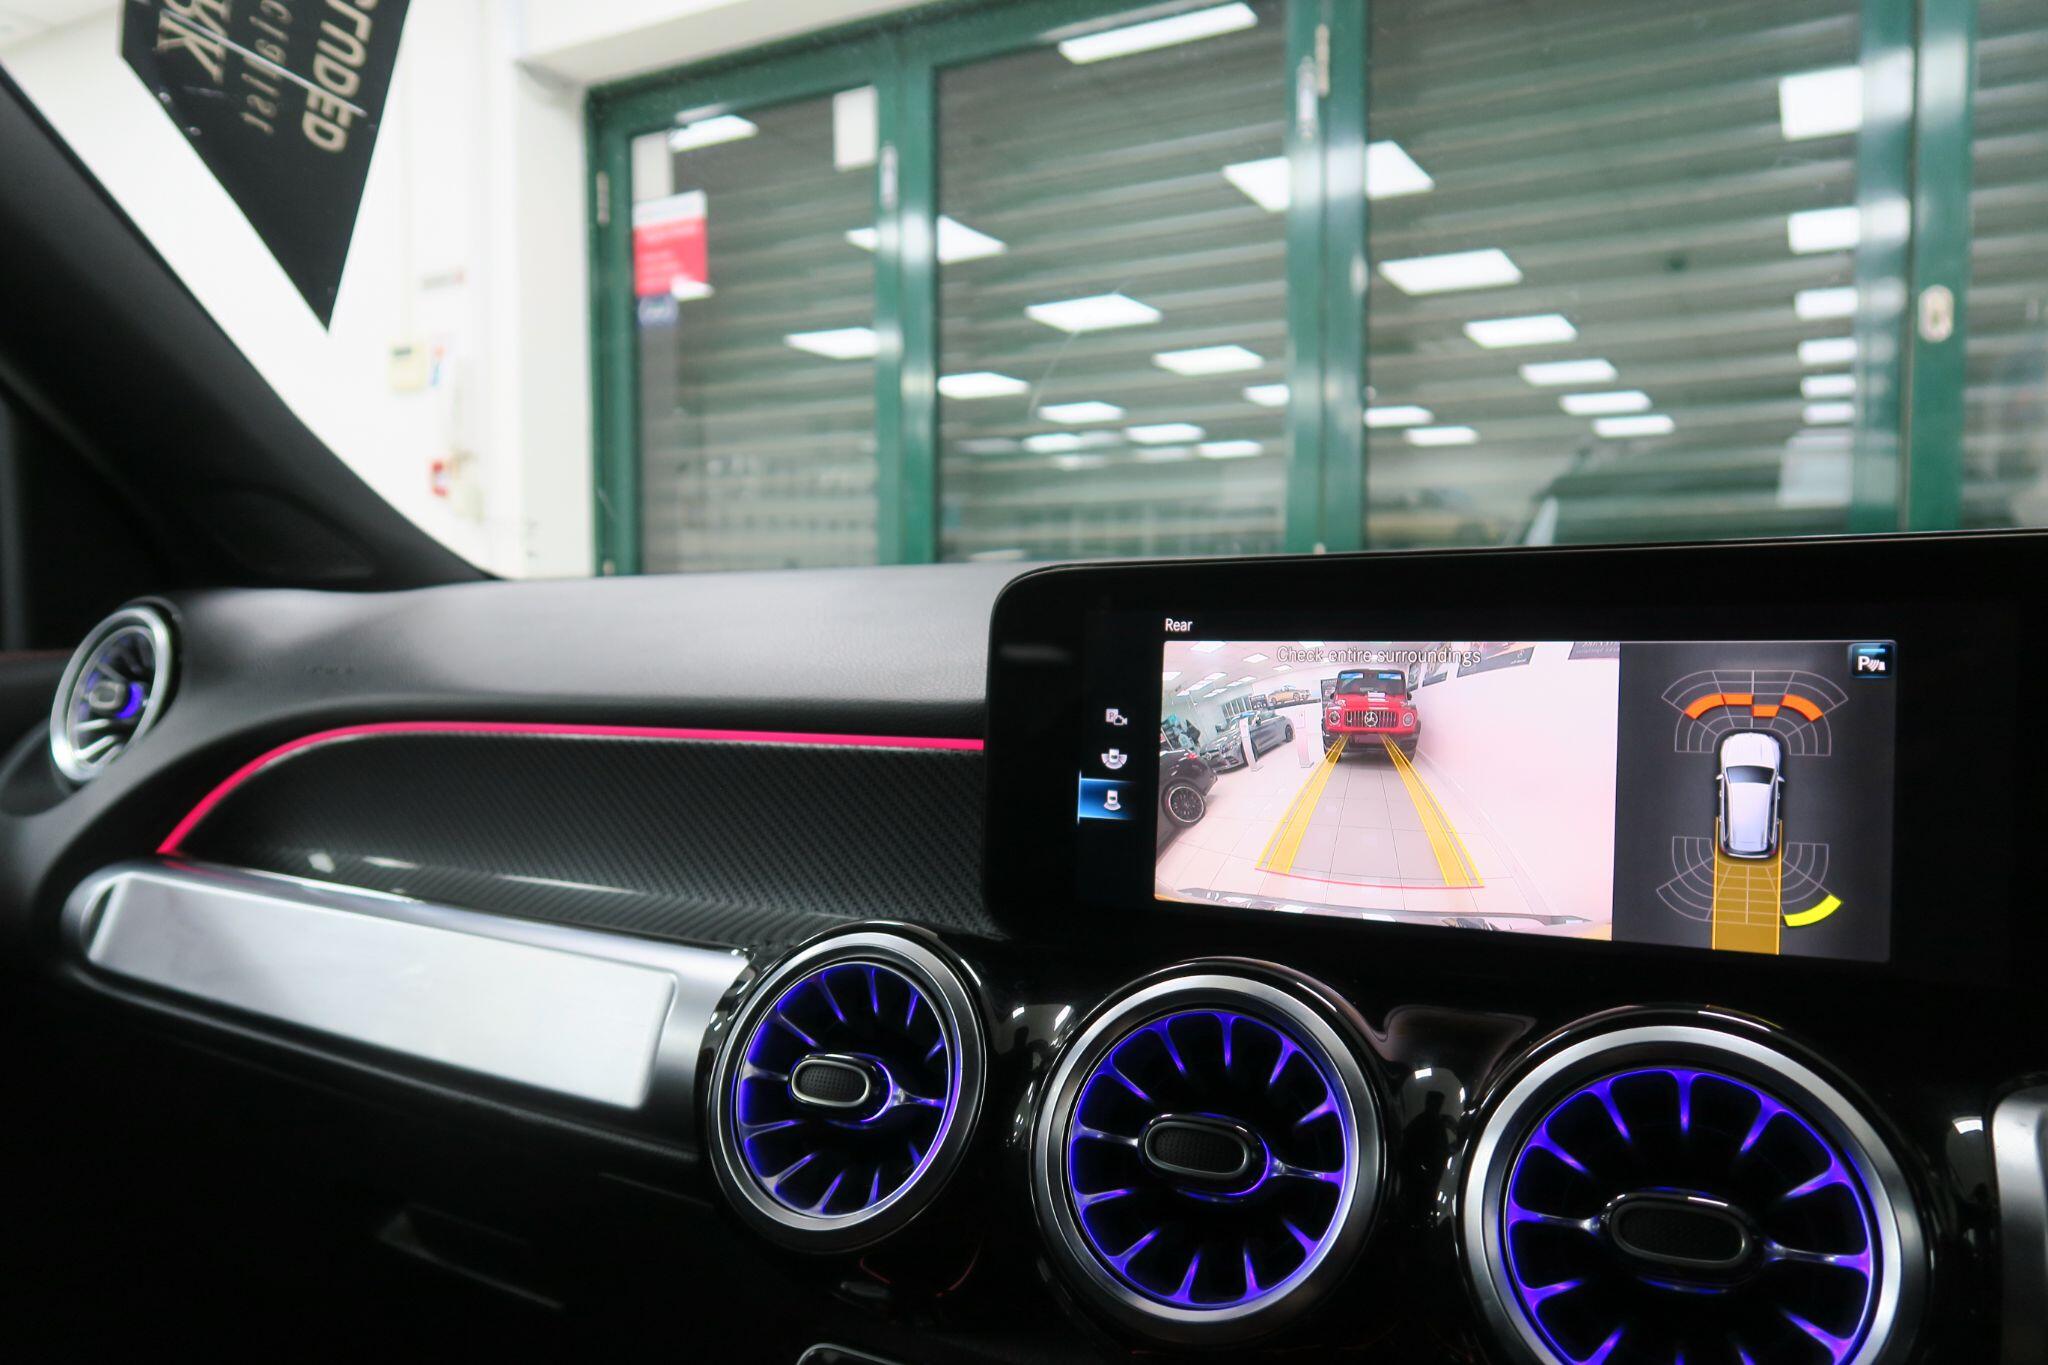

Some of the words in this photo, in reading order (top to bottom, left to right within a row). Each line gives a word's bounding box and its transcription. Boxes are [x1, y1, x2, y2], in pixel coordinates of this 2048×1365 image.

[1164, 617, 1194, 632] Rear
[1276, 645, 1324, 664] Check
[1328, 646, 1373, 664] entire
[1376, 648, 1482, 668] surroundings
